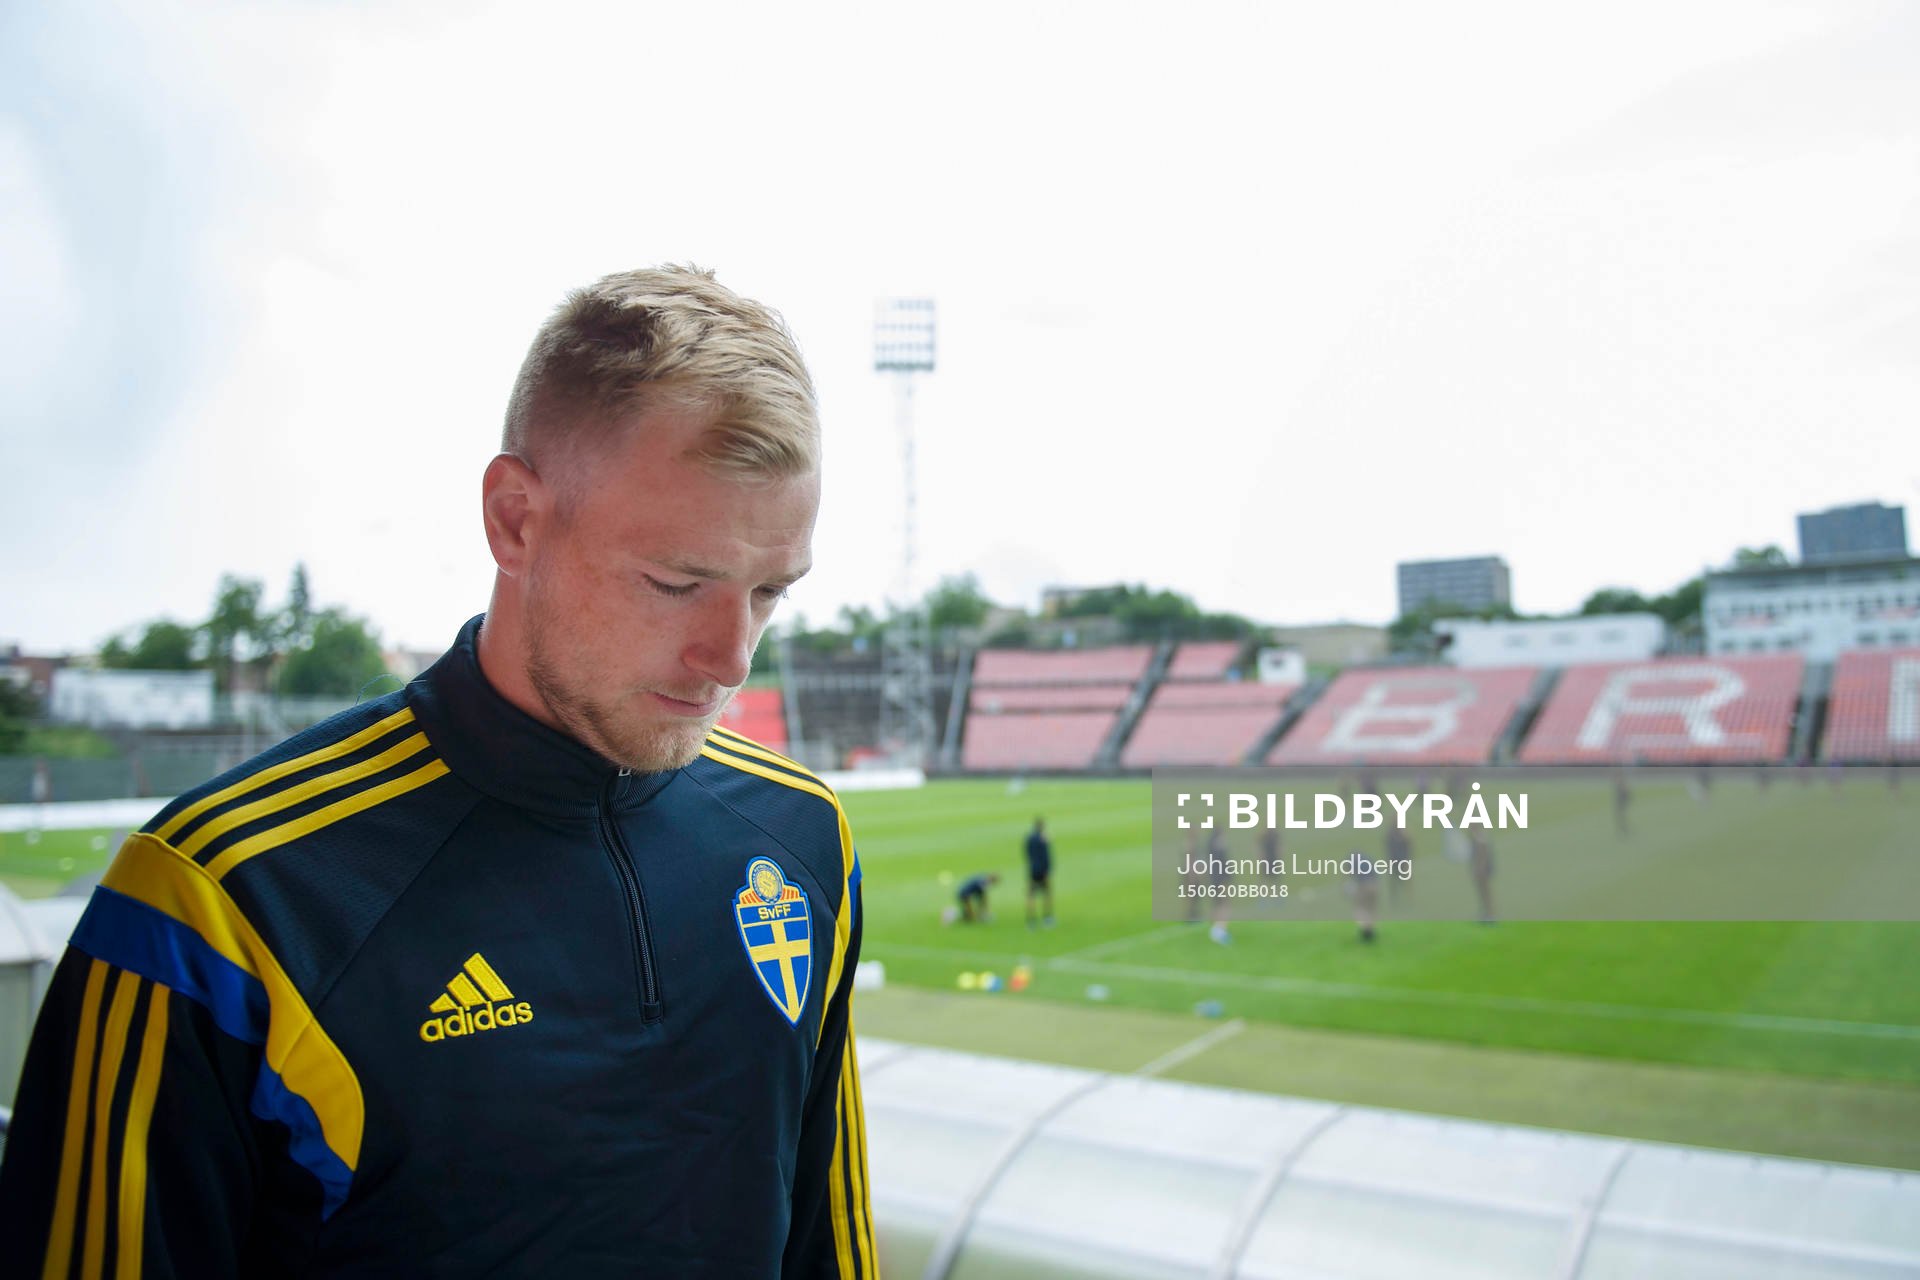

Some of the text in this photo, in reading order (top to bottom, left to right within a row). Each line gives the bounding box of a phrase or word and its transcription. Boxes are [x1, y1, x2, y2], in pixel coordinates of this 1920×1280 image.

[1320, 657, 1920, 753] BR
[758, 903, 791, 920] SvFF
[420, 1001, 534, 1042] adidas
